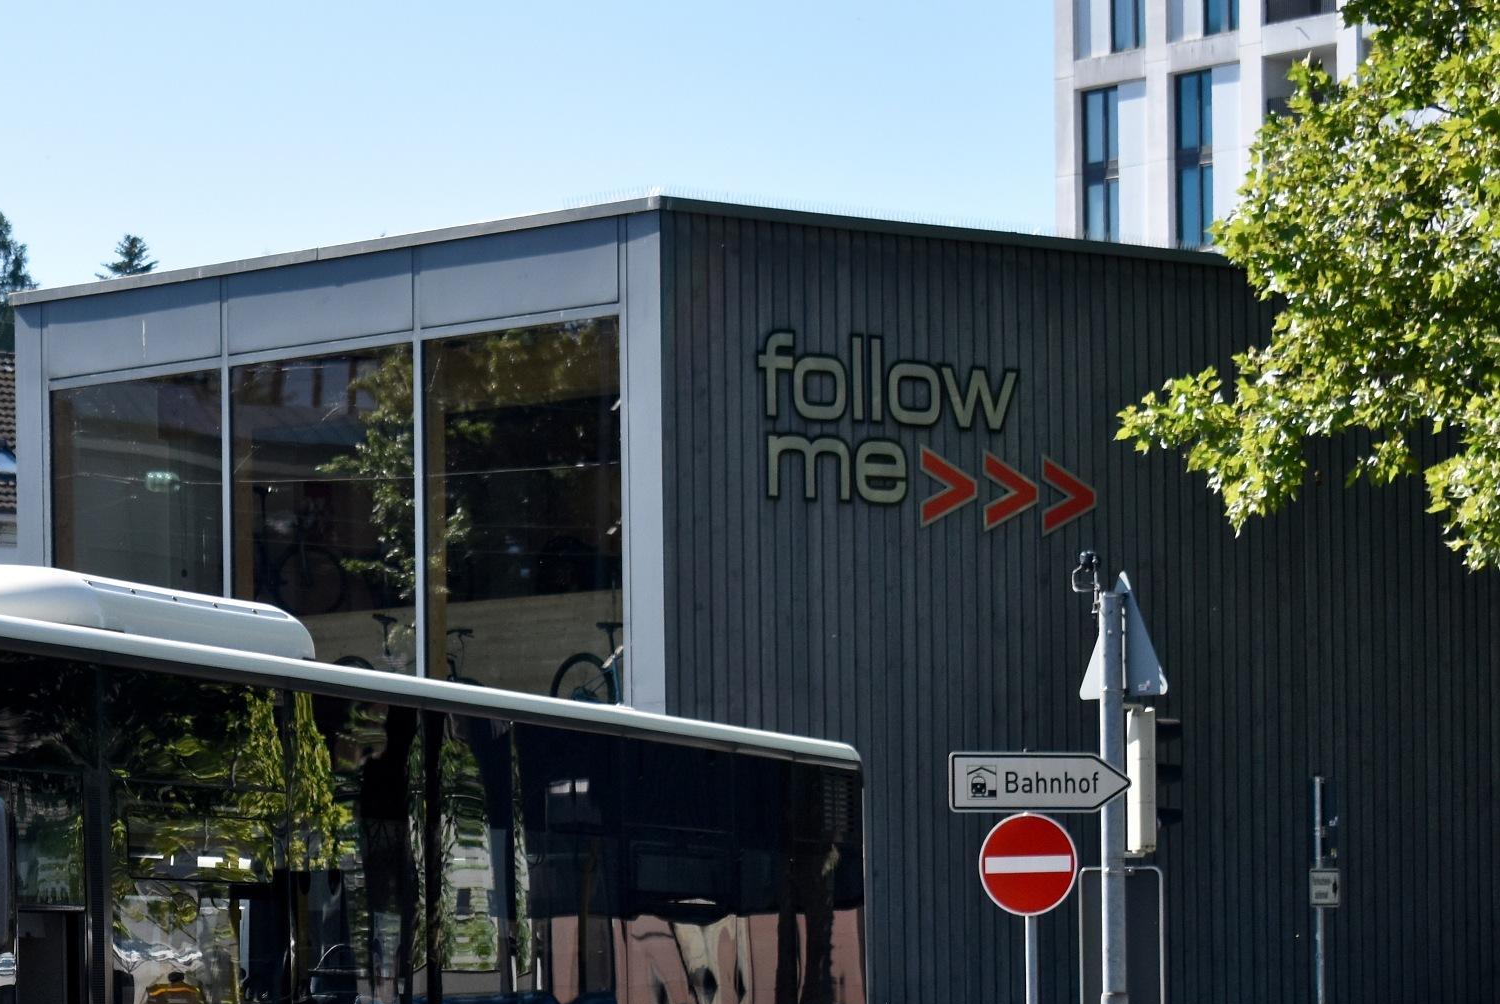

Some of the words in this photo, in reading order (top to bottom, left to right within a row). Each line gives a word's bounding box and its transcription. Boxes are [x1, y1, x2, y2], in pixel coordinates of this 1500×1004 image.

[757, 330, 1019, 430] follow
[767, 434, 907, 504] me
[1005, 771, 1099, 794] Bahnhof
